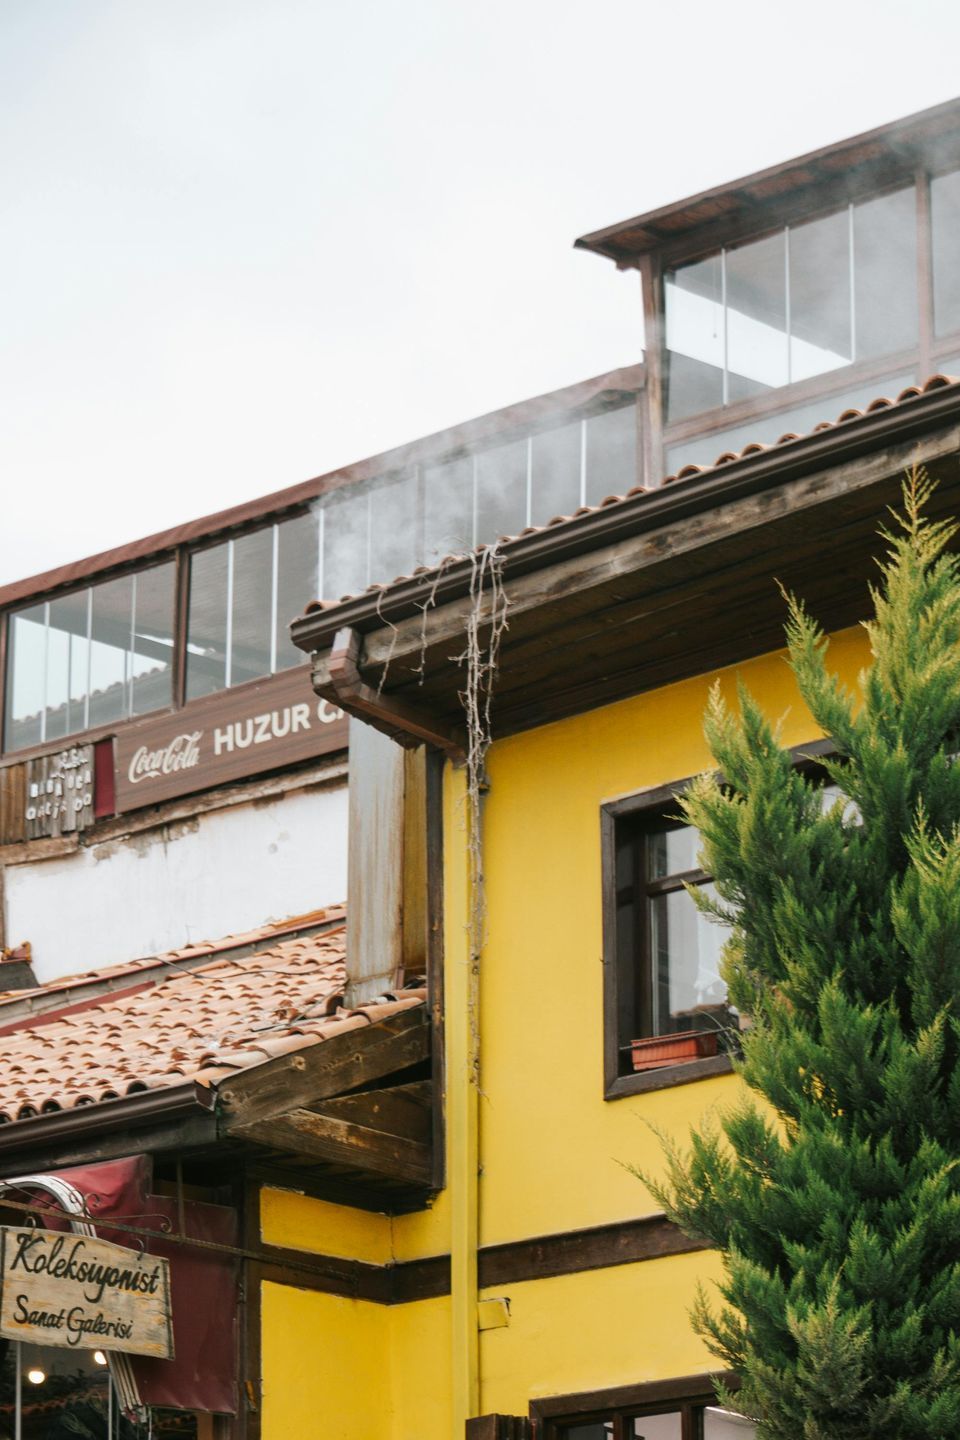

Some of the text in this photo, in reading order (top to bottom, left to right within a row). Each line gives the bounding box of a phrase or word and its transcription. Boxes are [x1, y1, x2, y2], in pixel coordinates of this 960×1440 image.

[213, 703, 312, 756] HUZUR
[10, 1233, 160, 1304] Koleksiyonist
[13, 1294, 134, 1346] Sanat Galerisi
